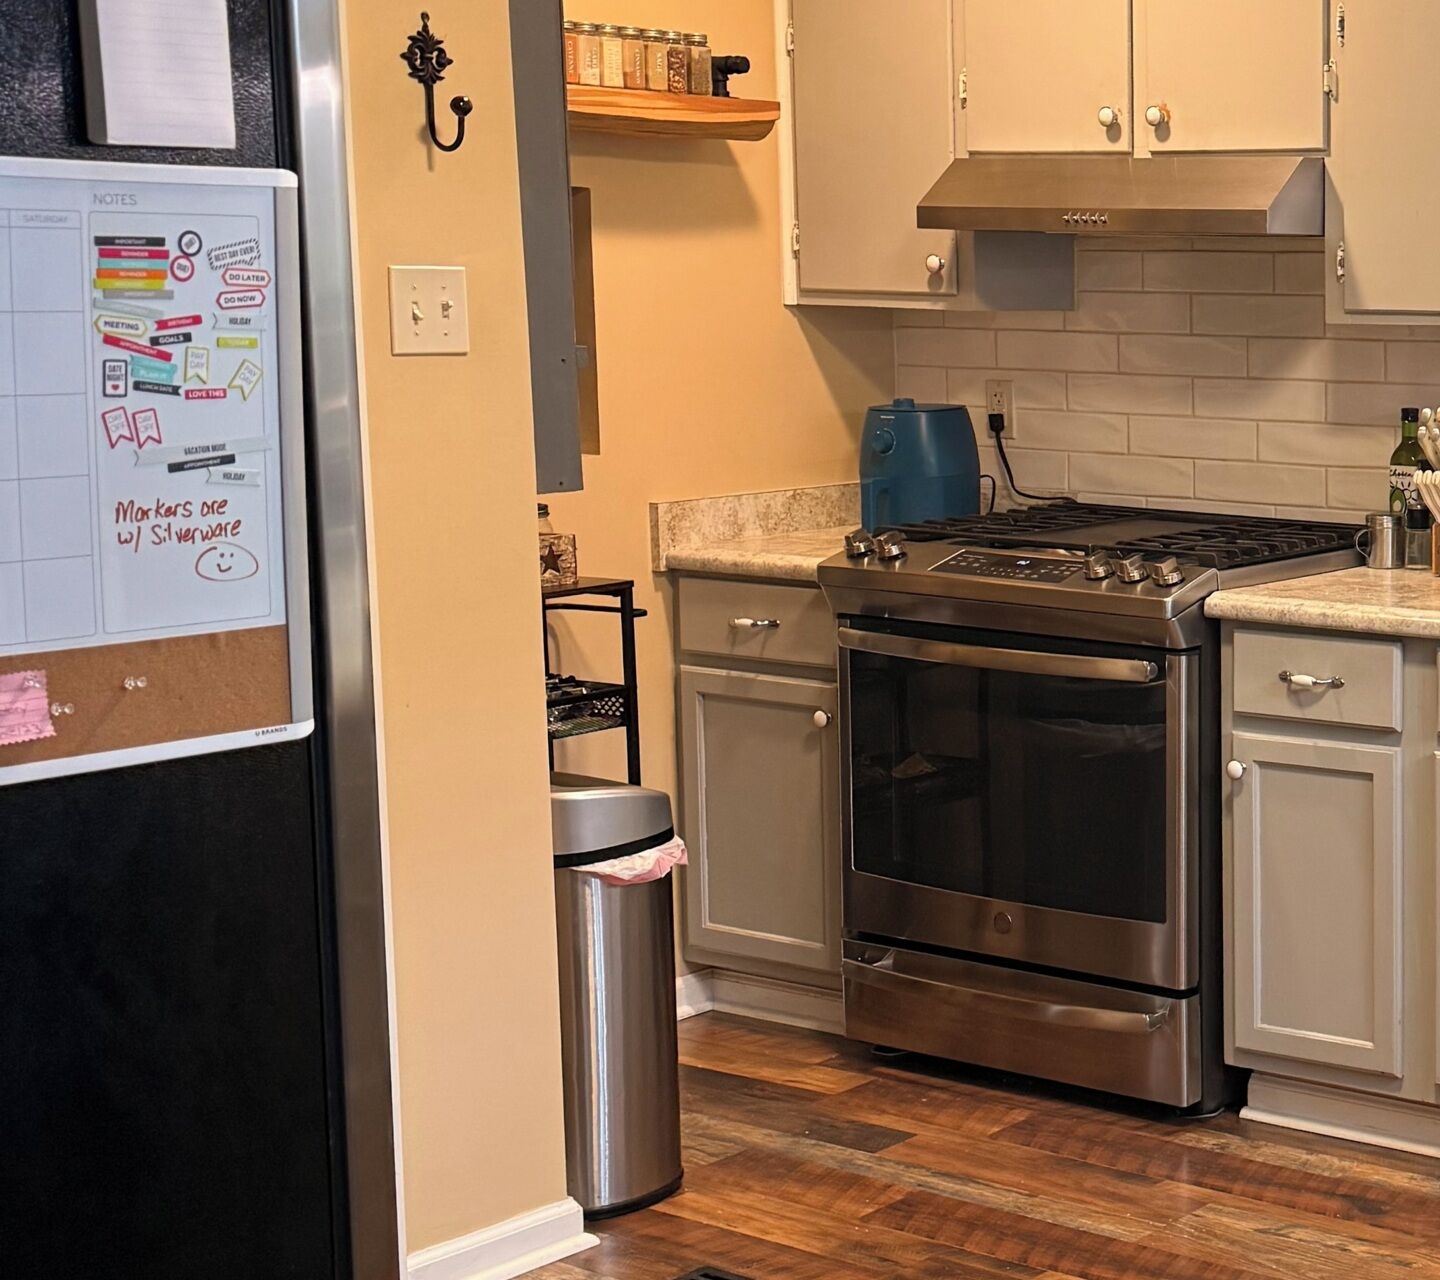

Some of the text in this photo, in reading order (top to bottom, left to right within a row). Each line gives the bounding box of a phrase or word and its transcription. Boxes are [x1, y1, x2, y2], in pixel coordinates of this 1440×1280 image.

[93, 193, 137, 206] NOTES
[22, 214, 69, 223] SATURDAY
[114, 237, 147, 245] IMPORTANT
[120, 250, 149, 258] REMINDER
[213, 245, 256, 262] BEST DAY EVER!
[119, 270, 148, 278] REMINDER
[229, 273, 266, 282] DO LATER
[224, 295, 256, 304] DO NOW
[103, 320, 140, 331] MEETING
[228, 317, 252, 326] HOLIDAY
[158, 334, 185, 344] GOALS
[120, 341, 159, 356] APPOINTMENT
[190, 351, 205, 360] PAY
[108, 364, 123, 373] DATE
[190, 361, 205, 370] DAY
[188, 389, 225, 398] LOVE THIS
[108, 414, 123, 424] DAY
[138, 414, 153, 424] DAY
[110, 423, 125, 433] OFF
[140, 423, 154, 433] OFF
[184, 443, 227, 456] VACATION MODE
[184, 458, 222, 469] APPOINTMENT
[222, 470, 246, 481] HOLIDAY
[115, 498, 229, 524] Markers are
[118, 519, 242, 553] w/ Silverware
[261, 726, 288, 736] BRANDS
